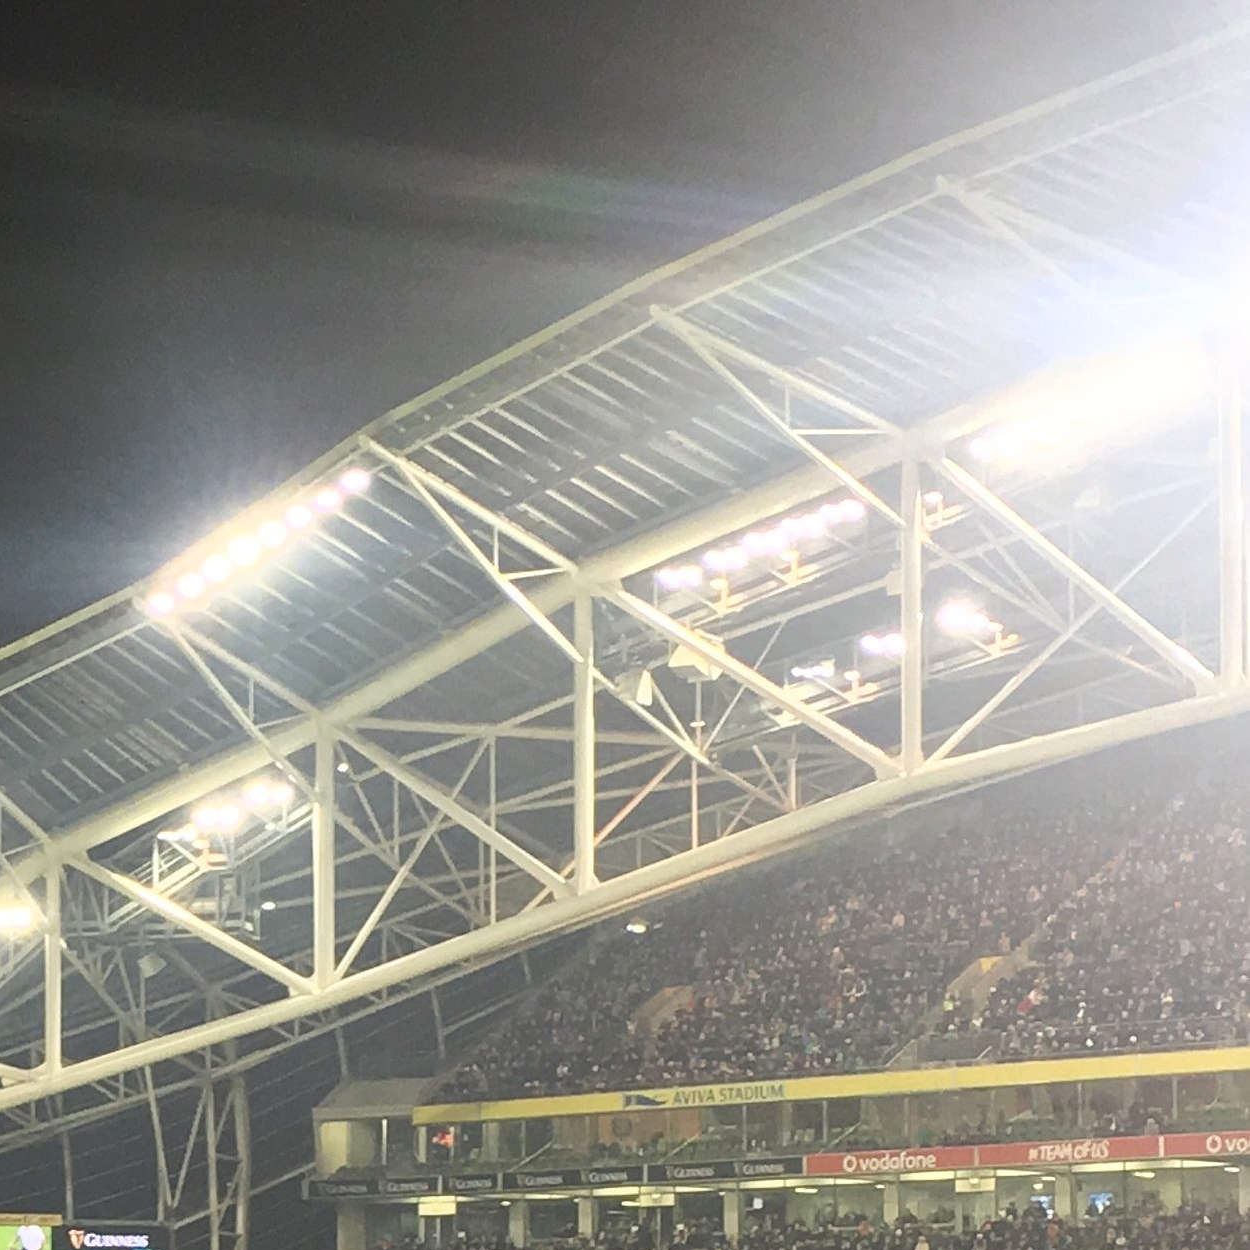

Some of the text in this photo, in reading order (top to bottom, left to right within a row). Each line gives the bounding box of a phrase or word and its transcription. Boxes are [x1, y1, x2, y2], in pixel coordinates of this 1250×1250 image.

[671, 1084, 785, 1105] AVIVA STADIUM
[860, 1152, 937, 1171] vodafone
[83, 1233, 149, 1247] GUINNESS
